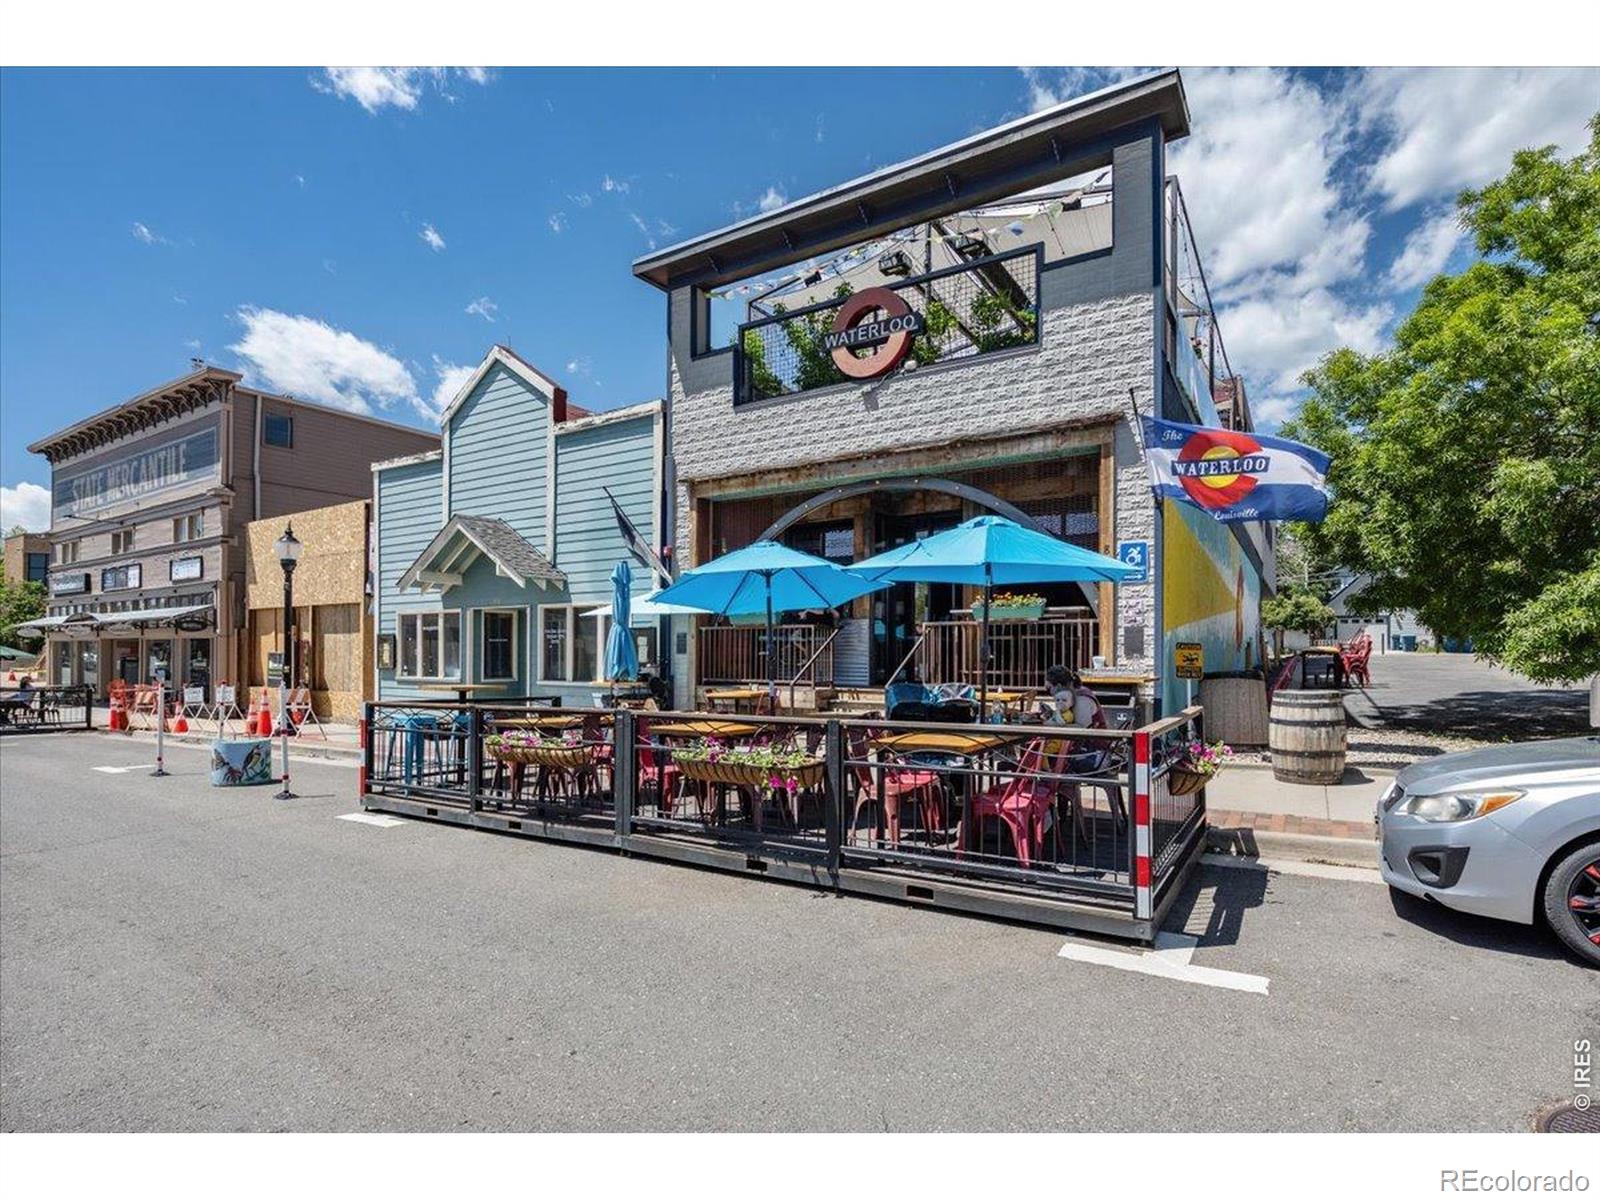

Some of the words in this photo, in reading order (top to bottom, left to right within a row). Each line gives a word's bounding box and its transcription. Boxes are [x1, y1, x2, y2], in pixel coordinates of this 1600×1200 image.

[824, 314, 918, 349] WATERLOO
[1162, 430, 1184, 442] The
[1174, 457, 1267, 477] WATERLOO
[72, 471, 105, 517] STATE
[107, 442, 189, 501] MERCANTILE
[1214, 507, 1260, 521] Louisville
